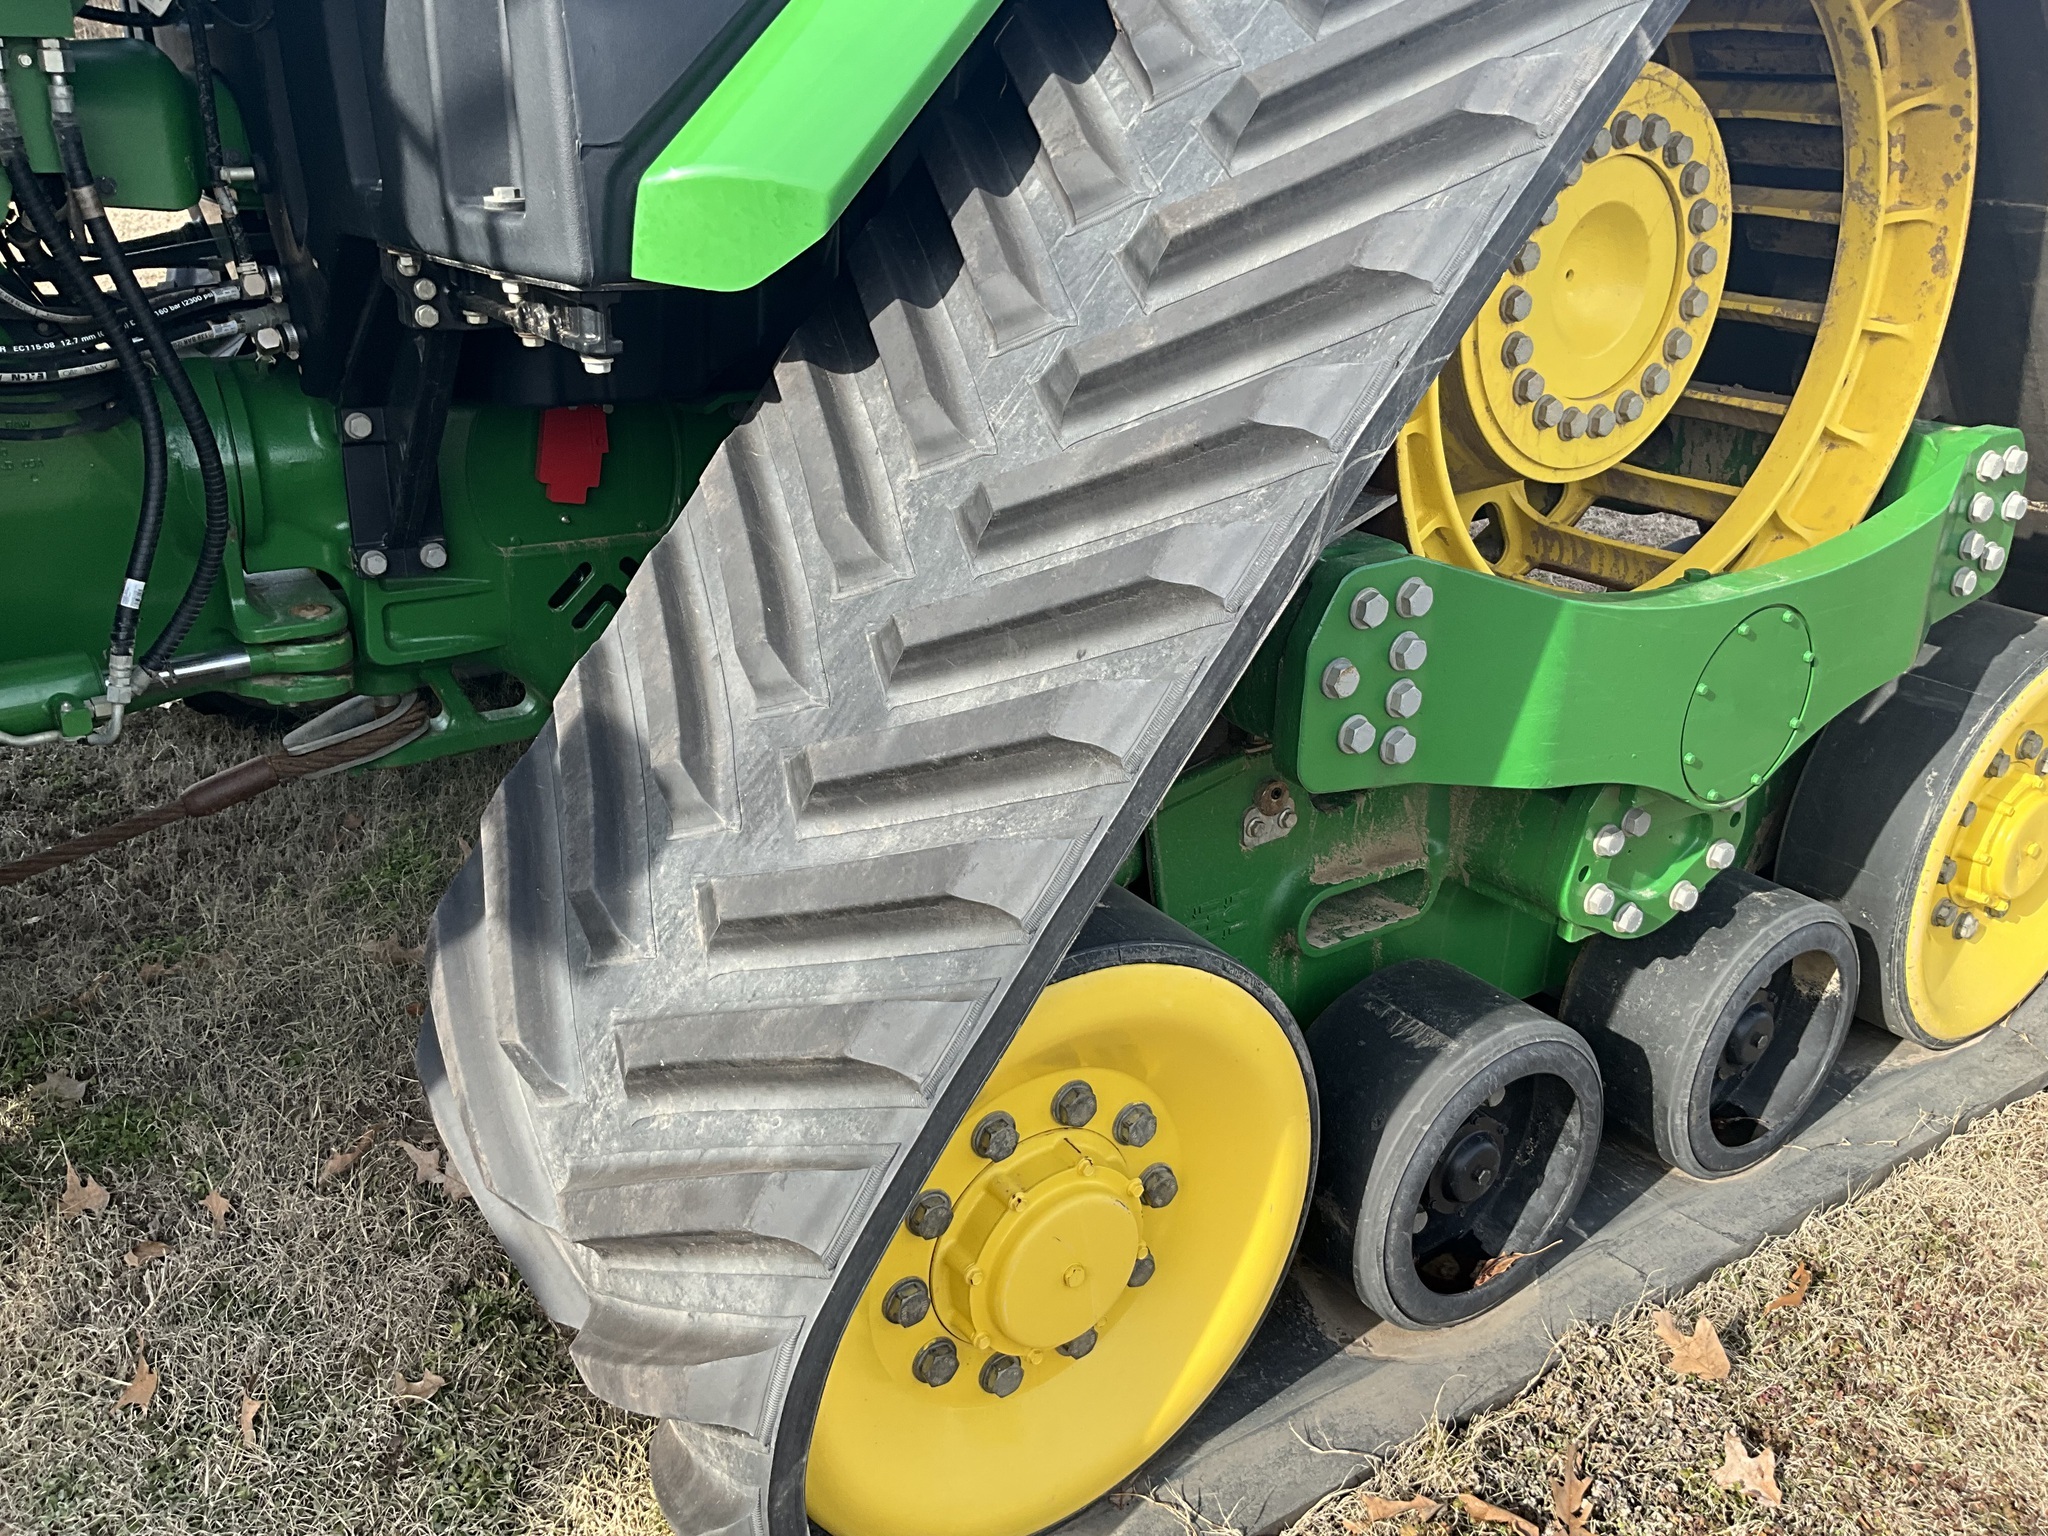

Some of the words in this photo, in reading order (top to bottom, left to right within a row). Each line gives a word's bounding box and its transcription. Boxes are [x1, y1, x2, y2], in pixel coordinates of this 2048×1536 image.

[154, 307, 169, 316] 160
[169, 303, 181, 311] bar
[181, 295, 202, 307] (2300
[13, 342, 56, 352] EC115-08
[60, 337, 78, 346] 12.7
[81, 334, 97, 342] mm
